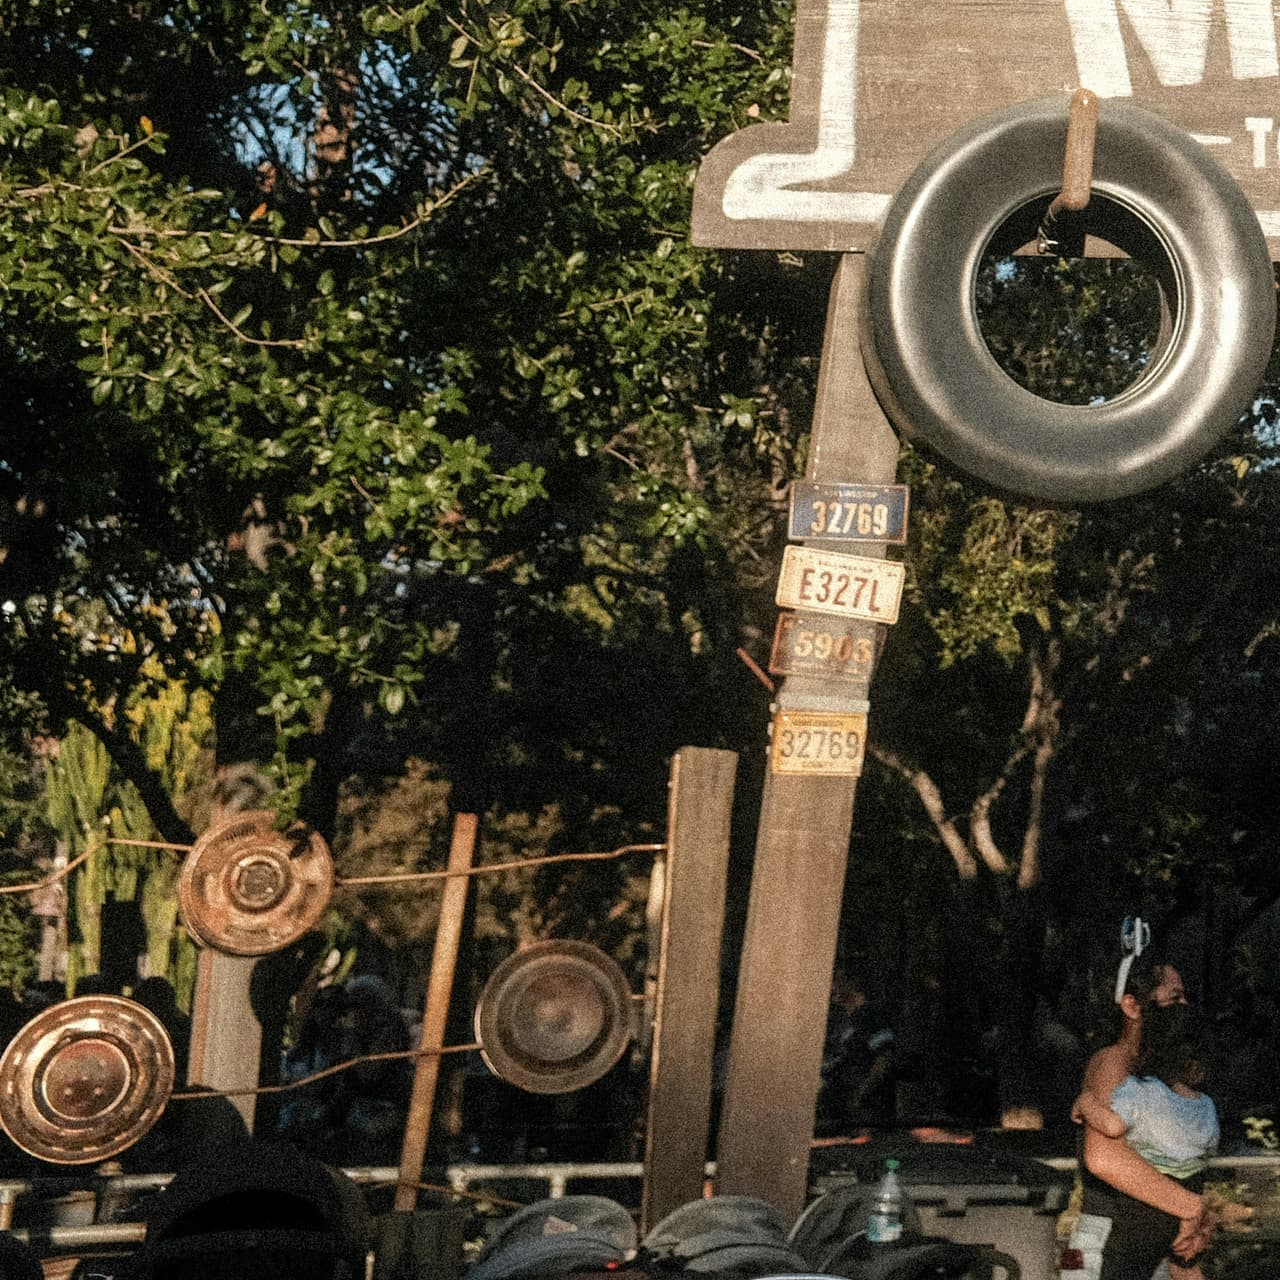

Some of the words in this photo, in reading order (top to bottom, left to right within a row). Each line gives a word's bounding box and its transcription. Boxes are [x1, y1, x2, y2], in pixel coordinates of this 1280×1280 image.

[810, 500, 889, 536] 32769
[798, 567, 881, 613] E327L
[780, 730, 860, 760] 32769
